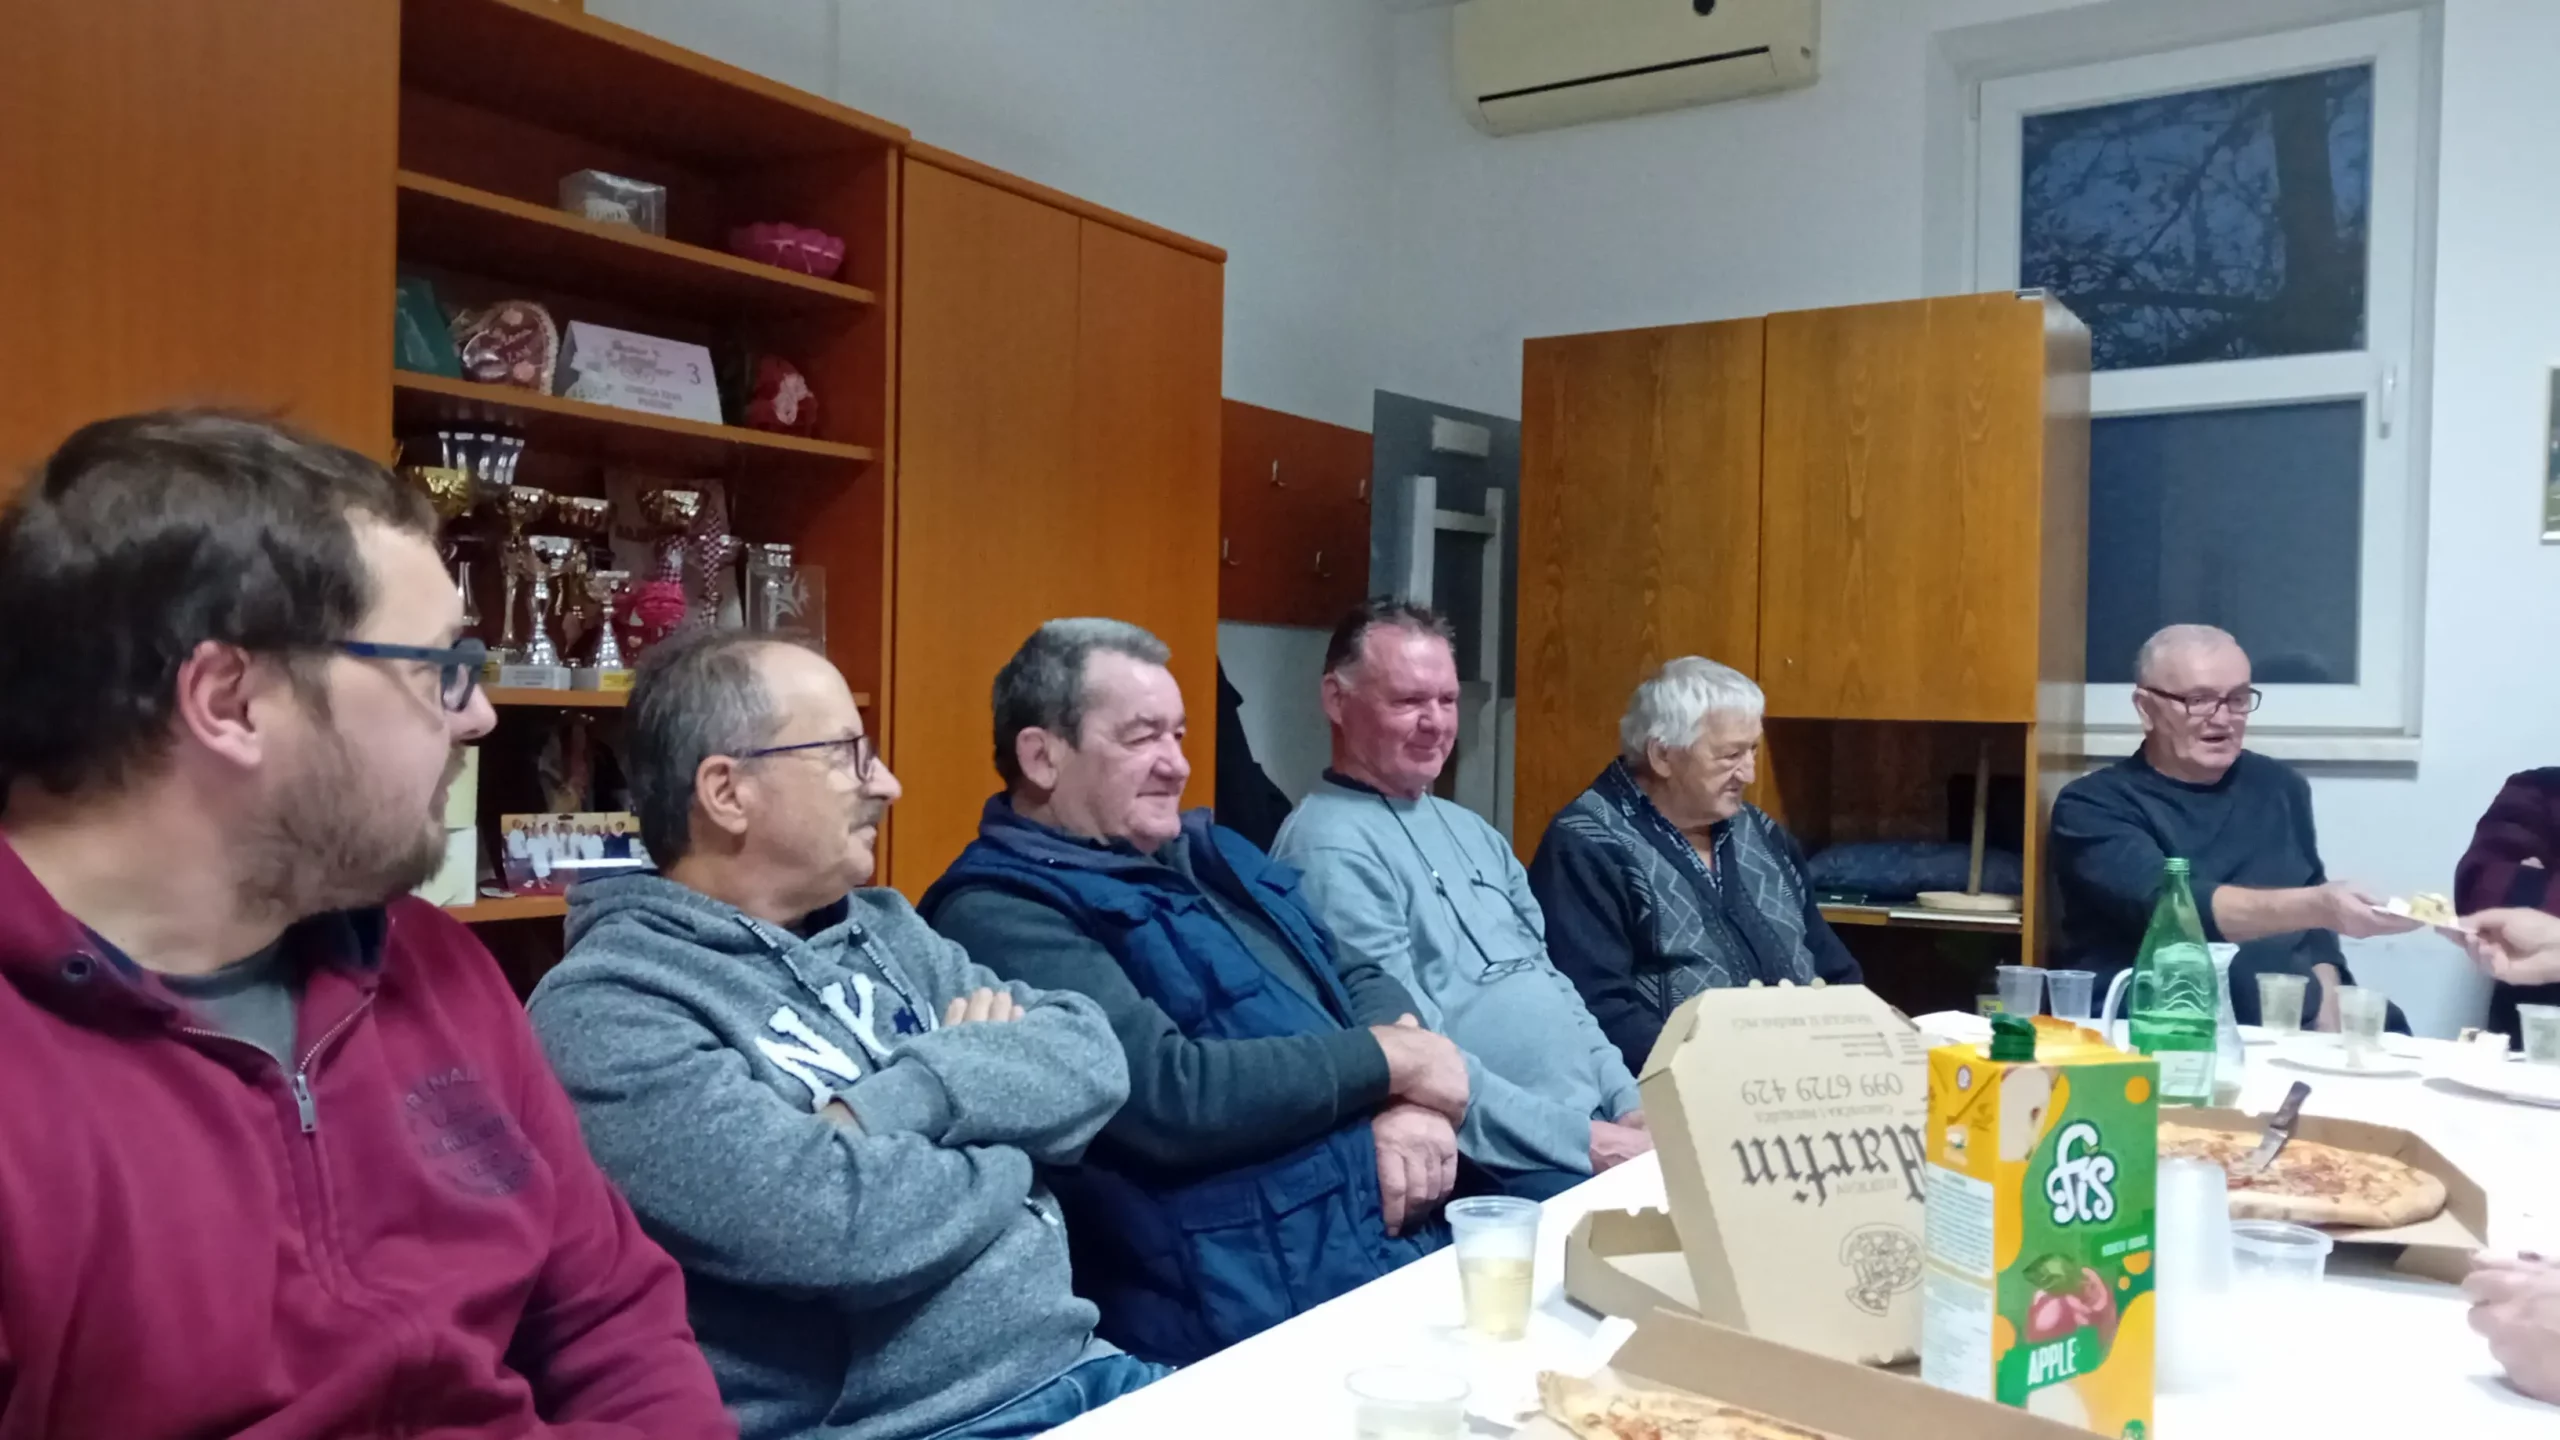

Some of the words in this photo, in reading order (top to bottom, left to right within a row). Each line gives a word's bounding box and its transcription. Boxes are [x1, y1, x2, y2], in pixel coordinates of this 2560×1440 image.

[686, 361, 701, 385] 3
[1740, 1077, 1787, 1106] 429
[1796, 1073, 1852, 1102] 6729
[1859, 1071, 1904, 1098] 099
[2026, 1337, 2078, 1386] APPLE
